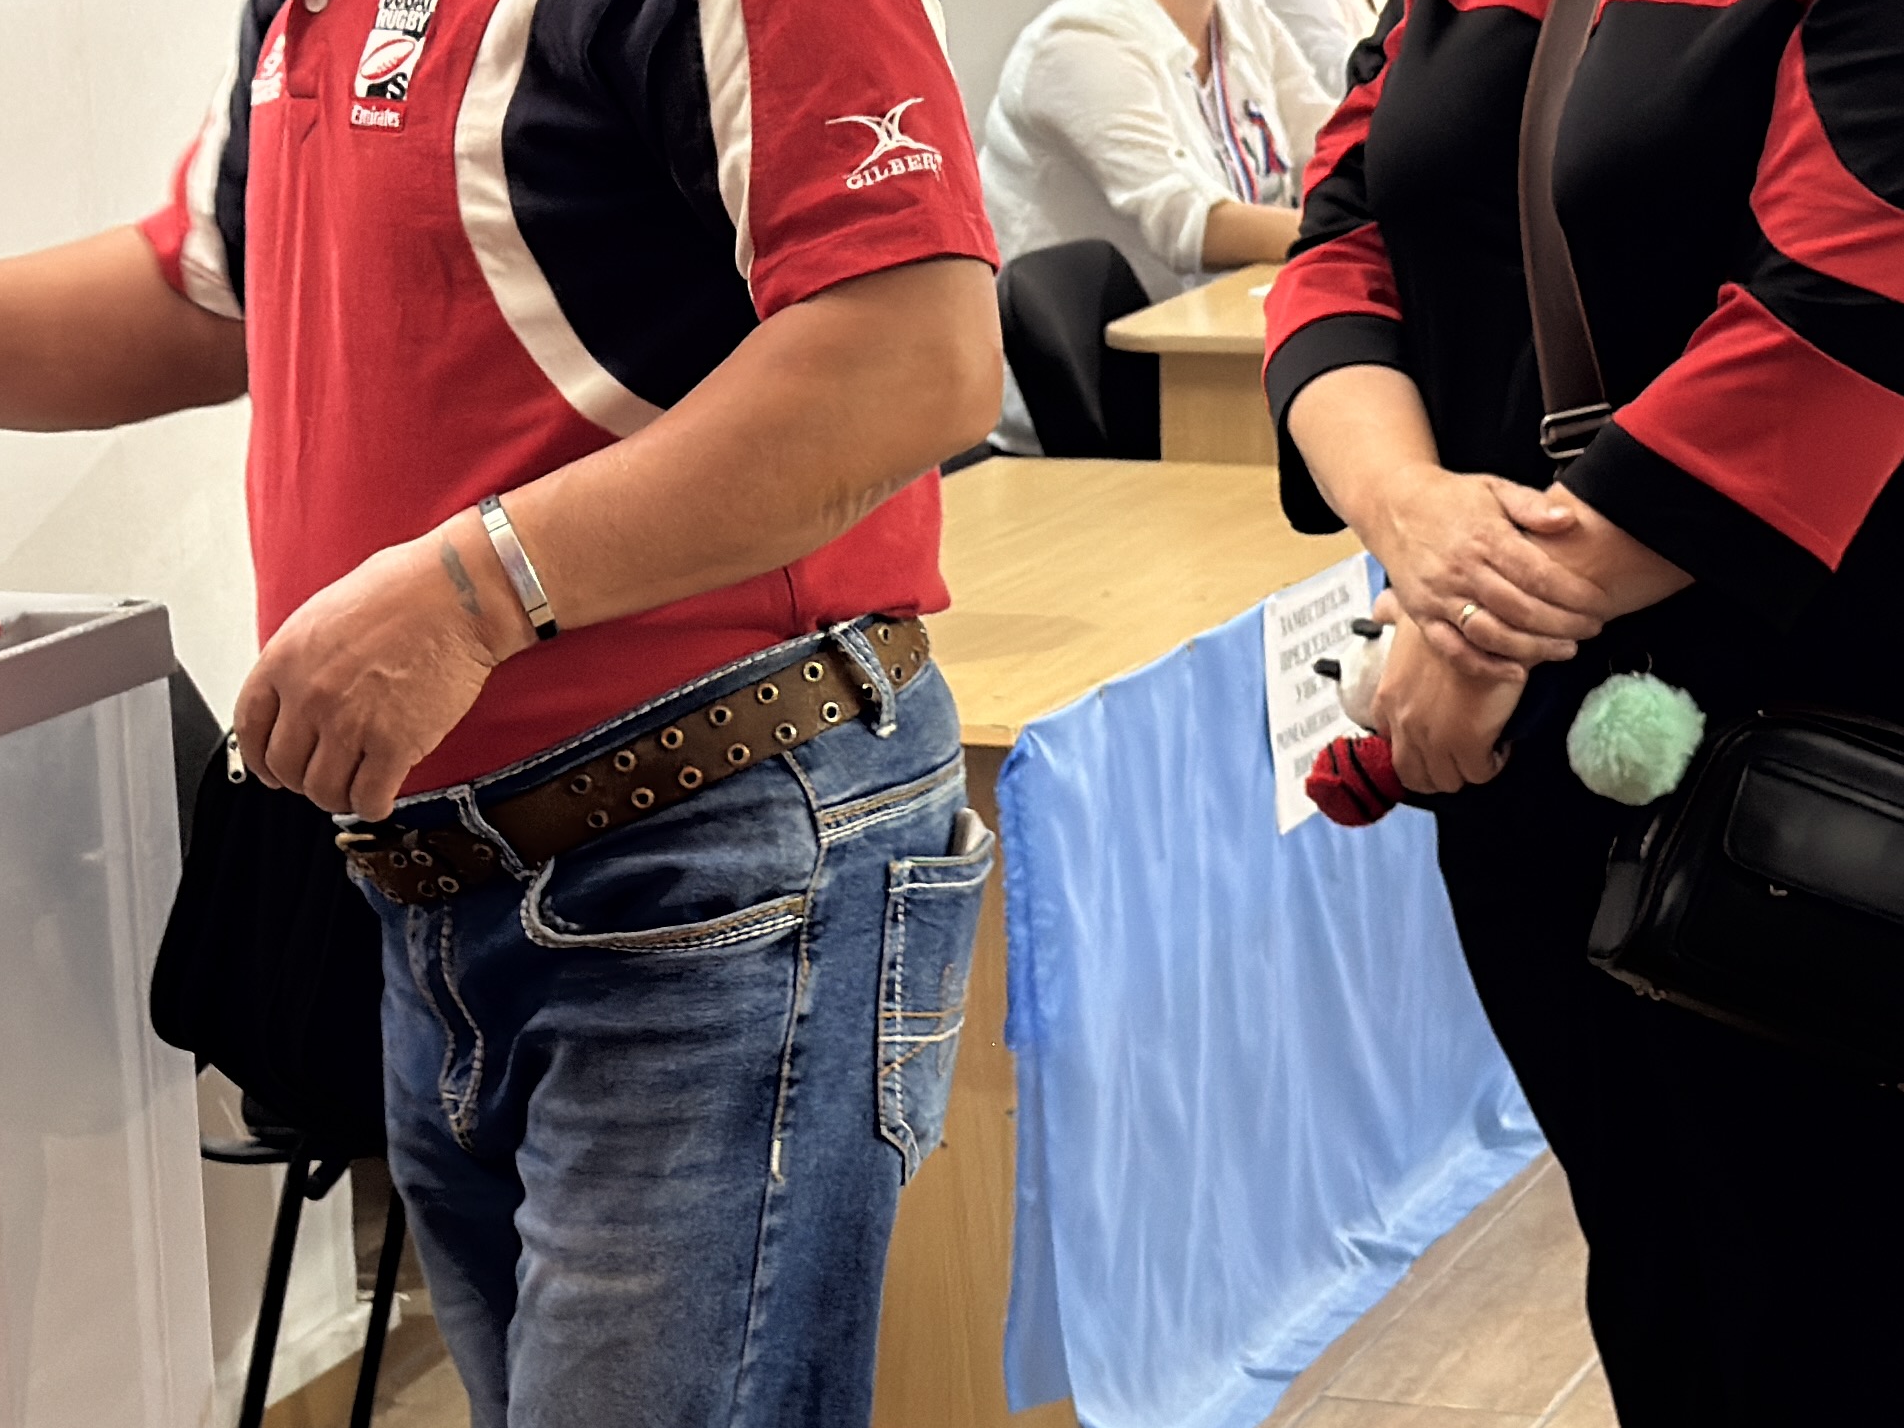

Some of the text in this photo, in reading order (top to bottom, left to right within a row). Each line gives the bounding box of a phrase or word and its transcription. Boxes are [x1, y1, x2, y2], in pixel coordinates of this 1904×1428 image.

[376, 9, 431, 33] RUGBY
[350, 103, 402, 128] Emirates
[846, 152, 943, 189] GILBERT
